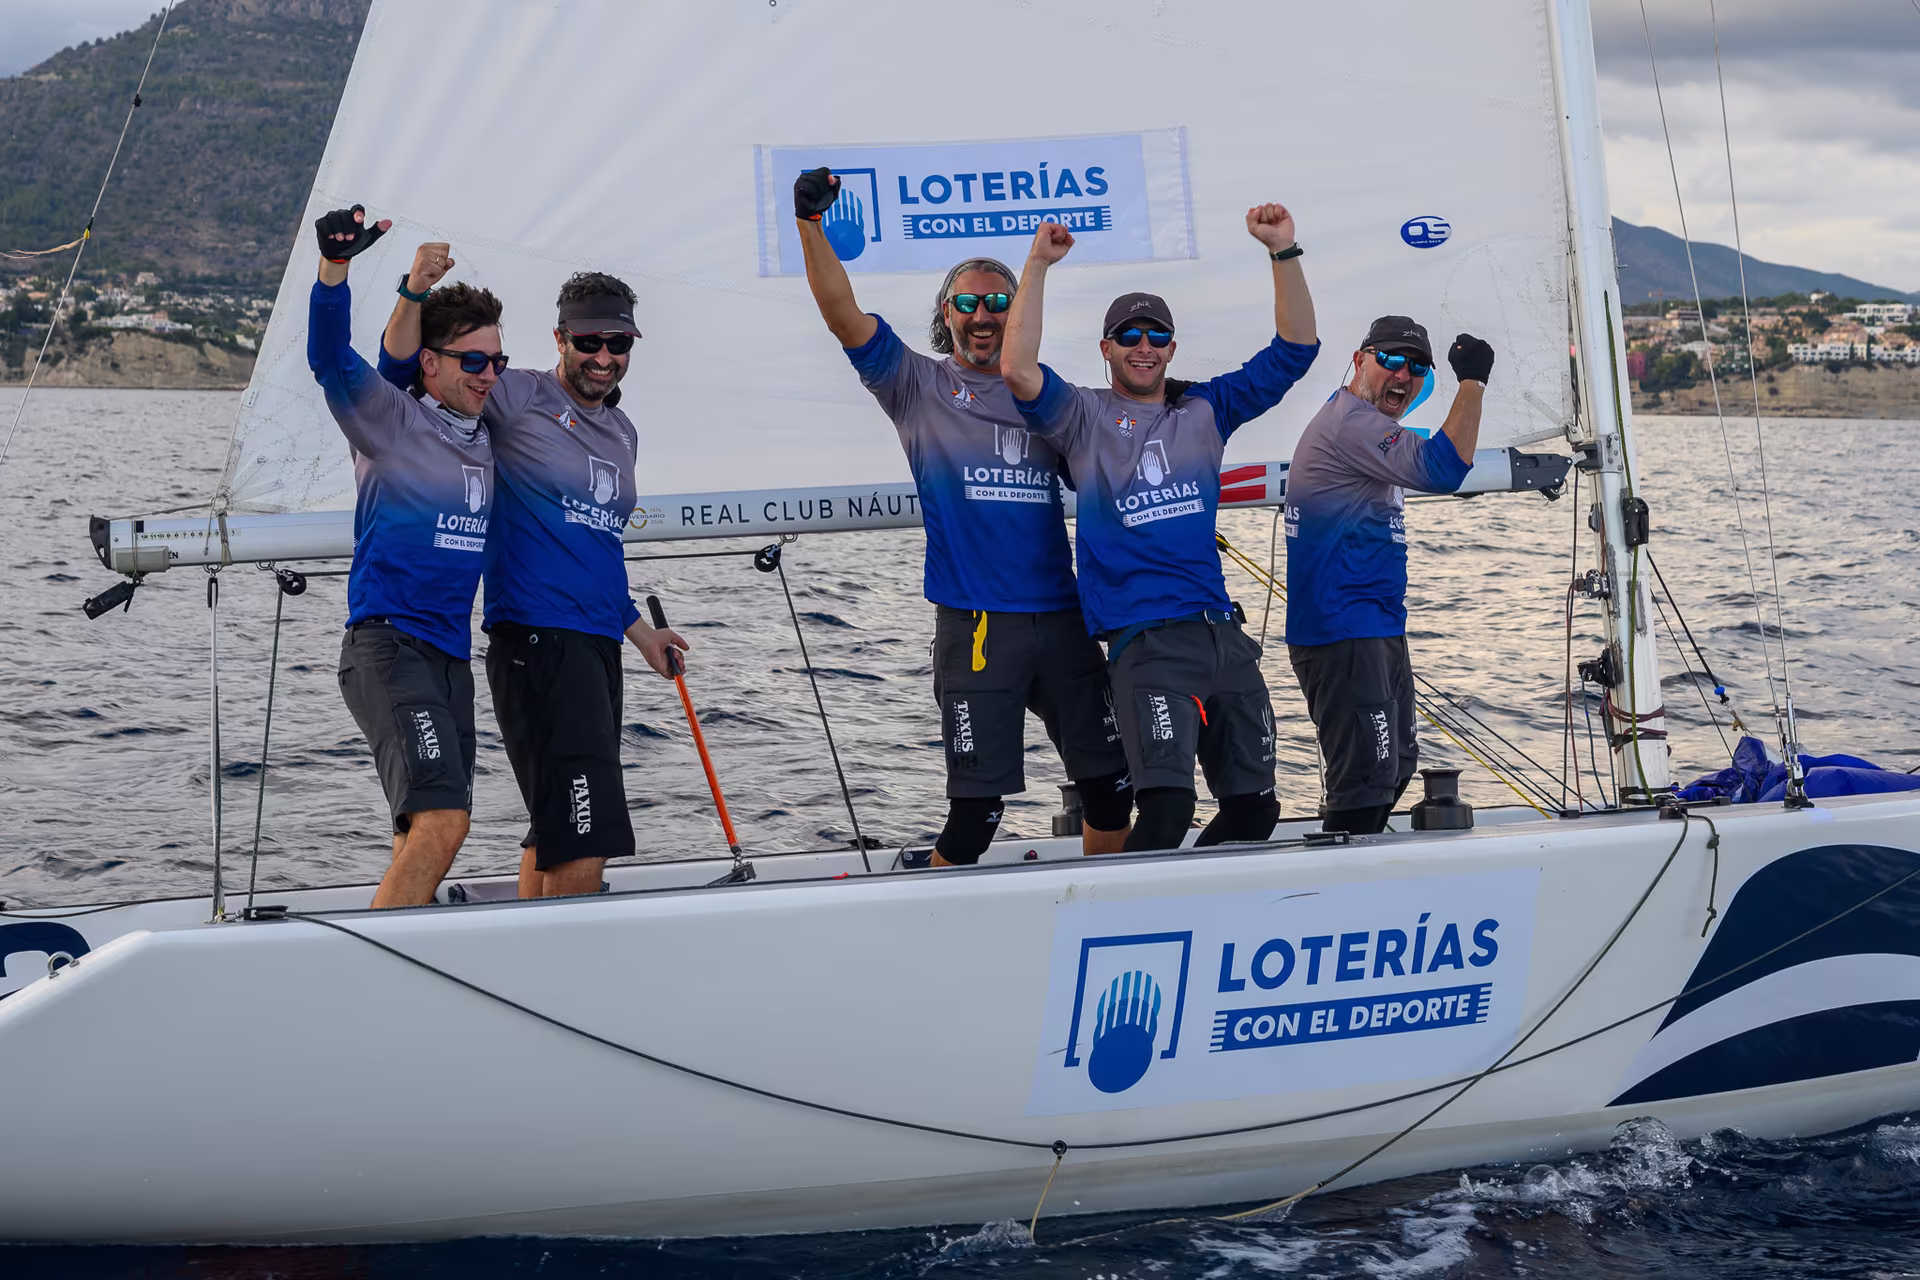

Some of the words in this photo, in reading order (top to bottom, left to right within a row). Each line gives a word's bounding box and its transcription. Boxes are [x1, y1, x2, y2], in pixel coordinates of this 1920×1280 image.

[898, 162, 1109, 205] LOTERÍAS
[918, 218, 966, 235] CON
[973, 217, 996, 233] EL
[1001, 211, 1096, 232] DEPORTE
[964, 467, 1051, 487] LOTERÍAS
[975, 489, 995, 497] CON
[998, 490, 1009, 498] EL
[1010, 491, 1046, 500] DEPORTE
[1115, 481, 1200, 512] LOTERÍAS
[436, 512, 489, 534] LOTERÍA
[681, 503, 750, 526] REAL
[763, 499, 834, 522] CLUB
[848, 491, 918, 518] NÁUT
[1130, 513, 1150, 522] CON
[1162, 503, 1196, 515] DEPORTE
[416, 710, 441, 760] TAXUS
[957, 700, 974, 752] TAXUS
[1154, 695, 1174, 740] TAXUS
[1374, 710, 1390, 760] TAXUS
[573, 774, 591, 834] TAXUS
[1218, 912, 1500, 993] LOTERÍAS
[1233, 1013, 1300, 1042] CON
[1309, 1006, 1339, 1034] EL
[1349, 993, 1471, 1030] DEPORTE
